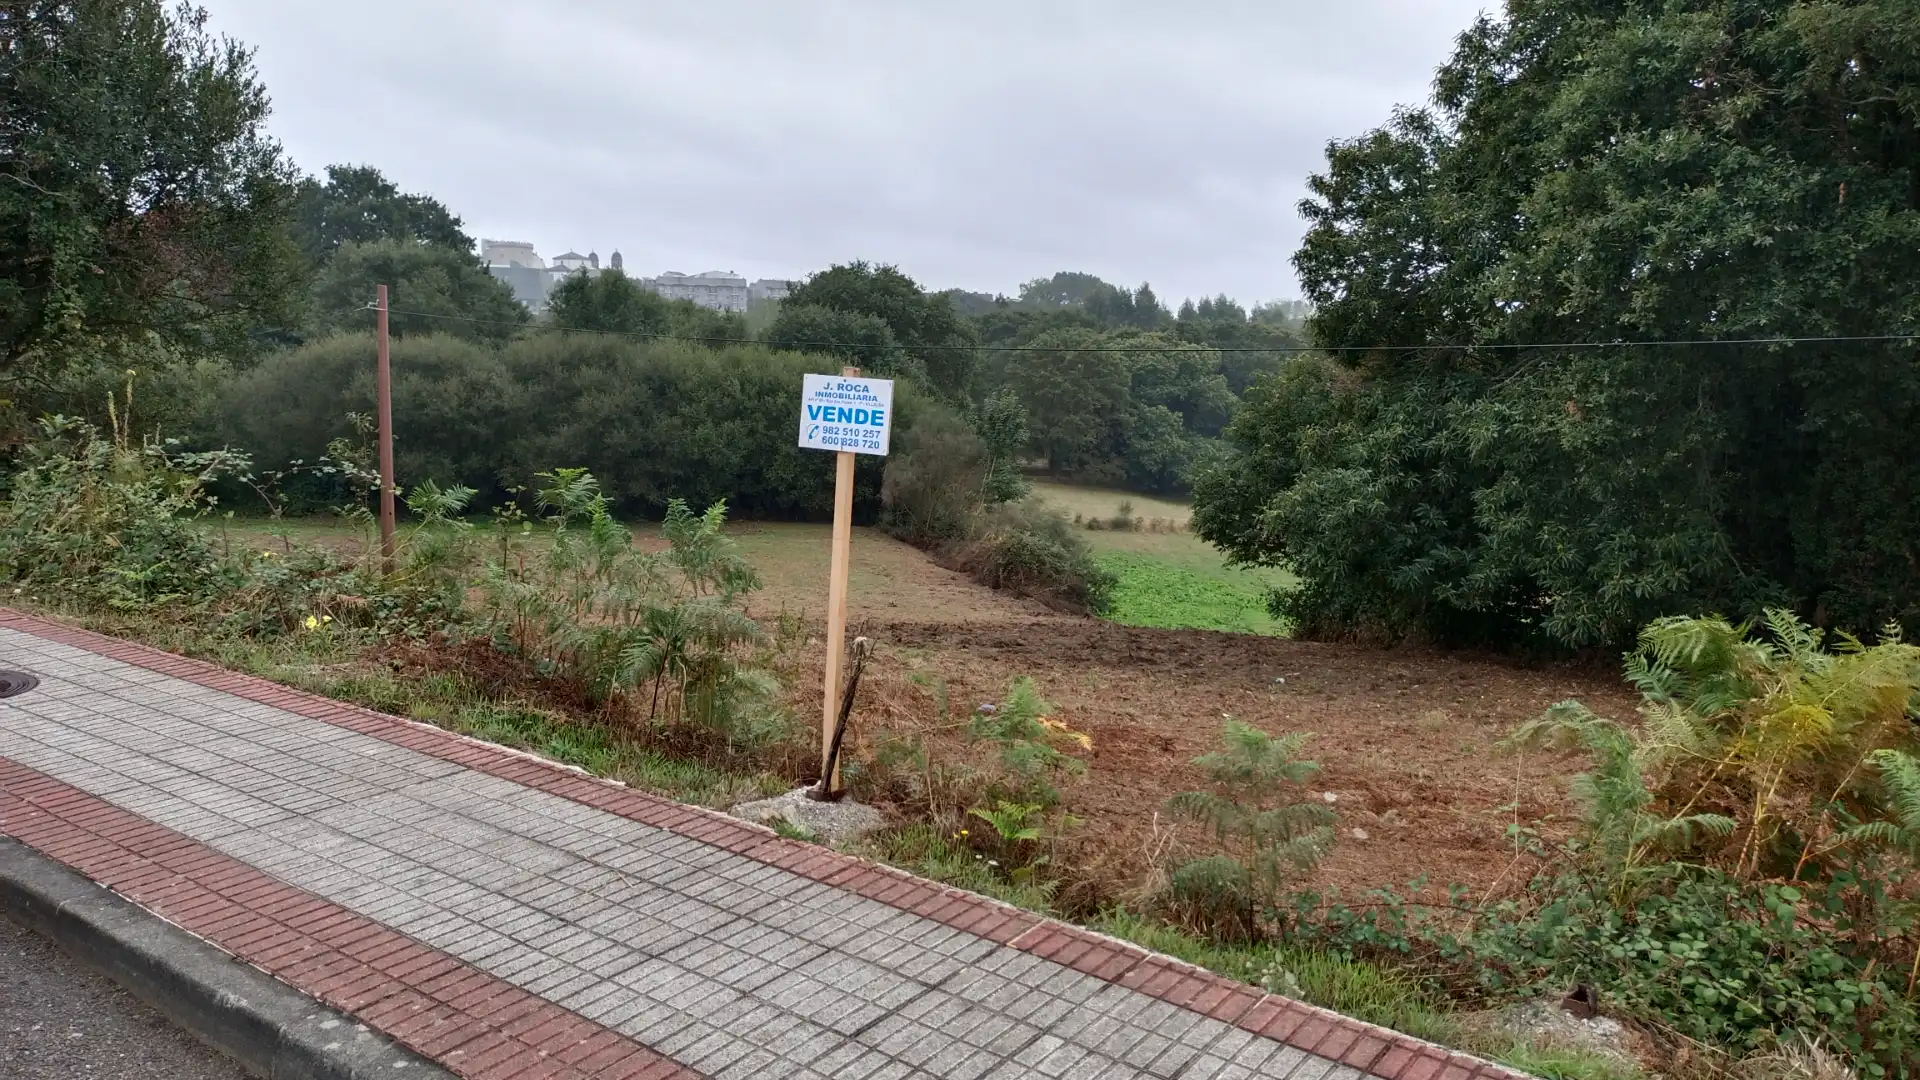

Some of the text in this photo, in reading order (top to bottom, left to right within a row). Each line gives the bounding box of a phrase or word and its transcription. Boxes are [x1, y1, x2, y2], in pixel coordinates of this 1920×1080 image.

[823, 382, 870, 393] J. ROCA
[815, 391, 878, 402] INMOBILIARIA
[807, 405, 885, 426] VENDE
[822, 426, 881, 439] 982 510 257
[822, 436, 880, 449] 600 828 720
